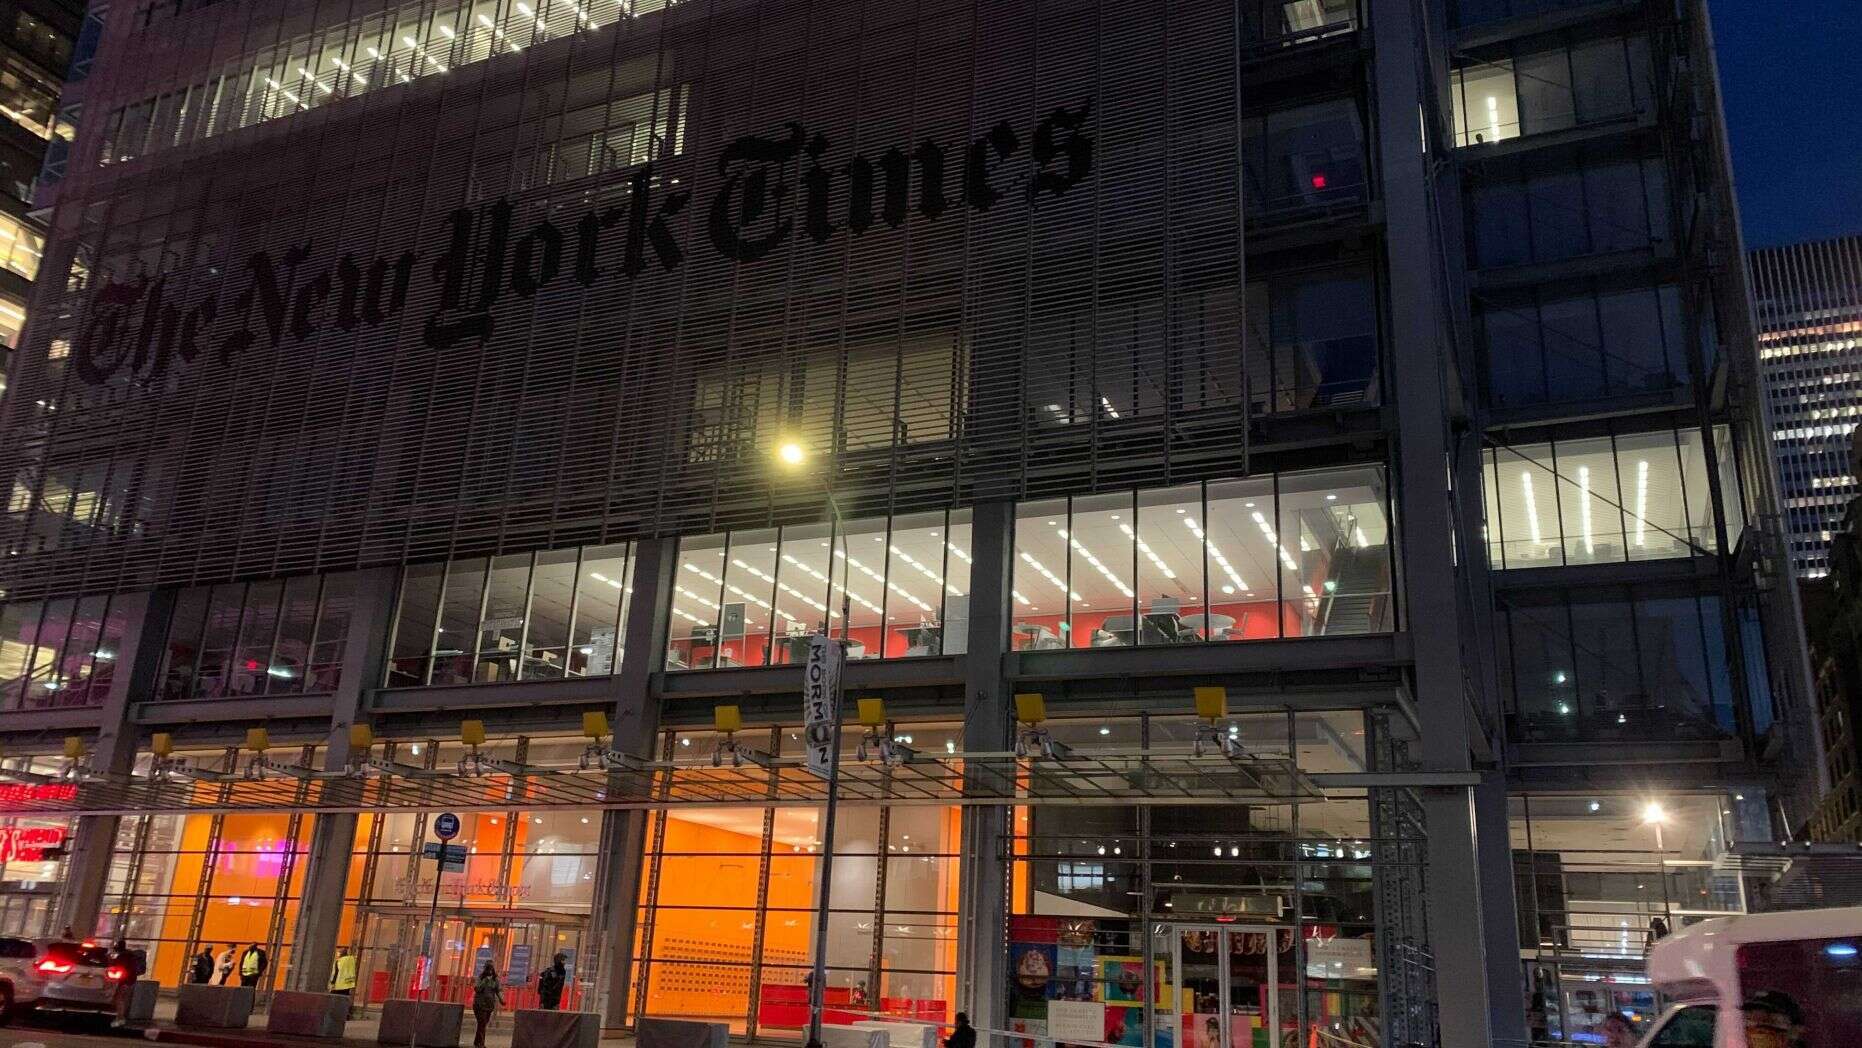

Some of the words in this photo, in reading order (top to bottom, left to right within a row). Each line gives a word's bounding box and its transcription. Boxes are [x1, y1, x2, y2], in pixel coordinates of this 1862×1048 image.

[79, 275, 217, 383] The
[220, 241, 418, 362] New
[426, 165, 690, 348] York
[710, 98, 1094, 262] Times
[810, 644, 829, 764] MORMON
